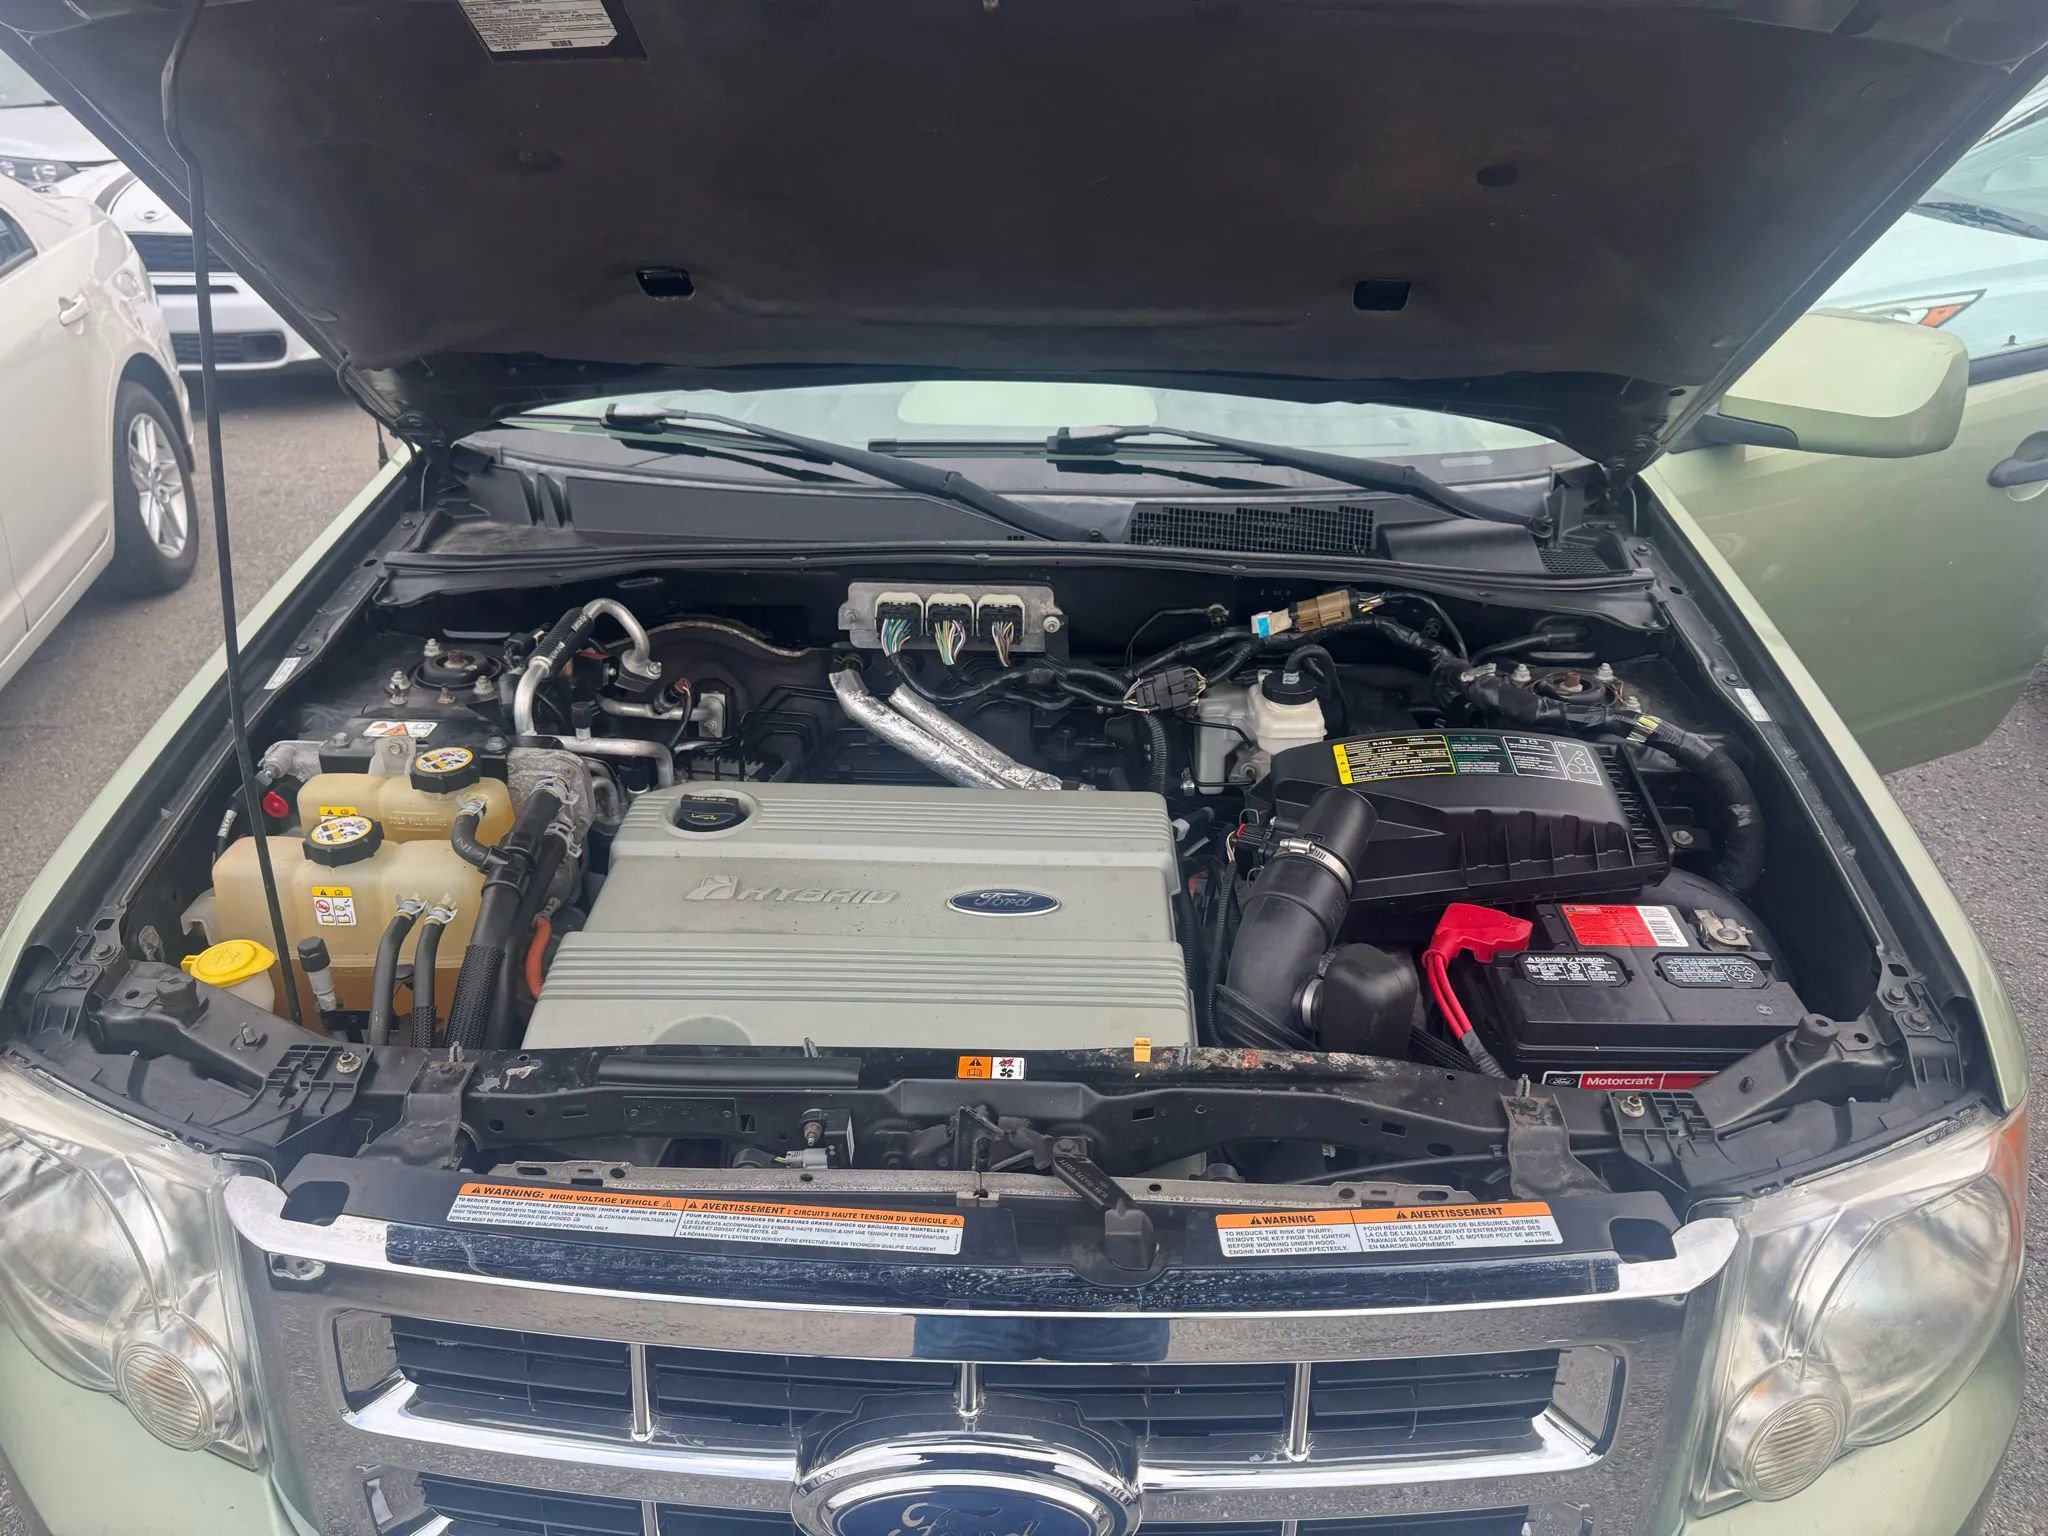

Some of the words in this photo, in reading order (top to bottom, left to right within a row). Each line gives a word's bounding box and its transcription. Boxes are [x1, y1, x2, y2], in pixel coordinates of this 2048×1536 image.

[737, 888, 899, 904] HYBRID
[974, 891, 1033, 910] Ford
[1586, 1076, 1655, 1086] Motorcraft
[483, 1187, 544, 1198] WARNING:
[576, 1195, 618, 1203] VOLTAGE
[701, 1202, 786, 1215] AVERTISSEMENT
[860, 1213, 894, 1221] TENSION
[909, 1216, 948, 1224] VÉHICULE
[1261, 1215, 1316, 1225] WARNING
[1410, 1208, 1502, 1219] AVERTISSEMENT
